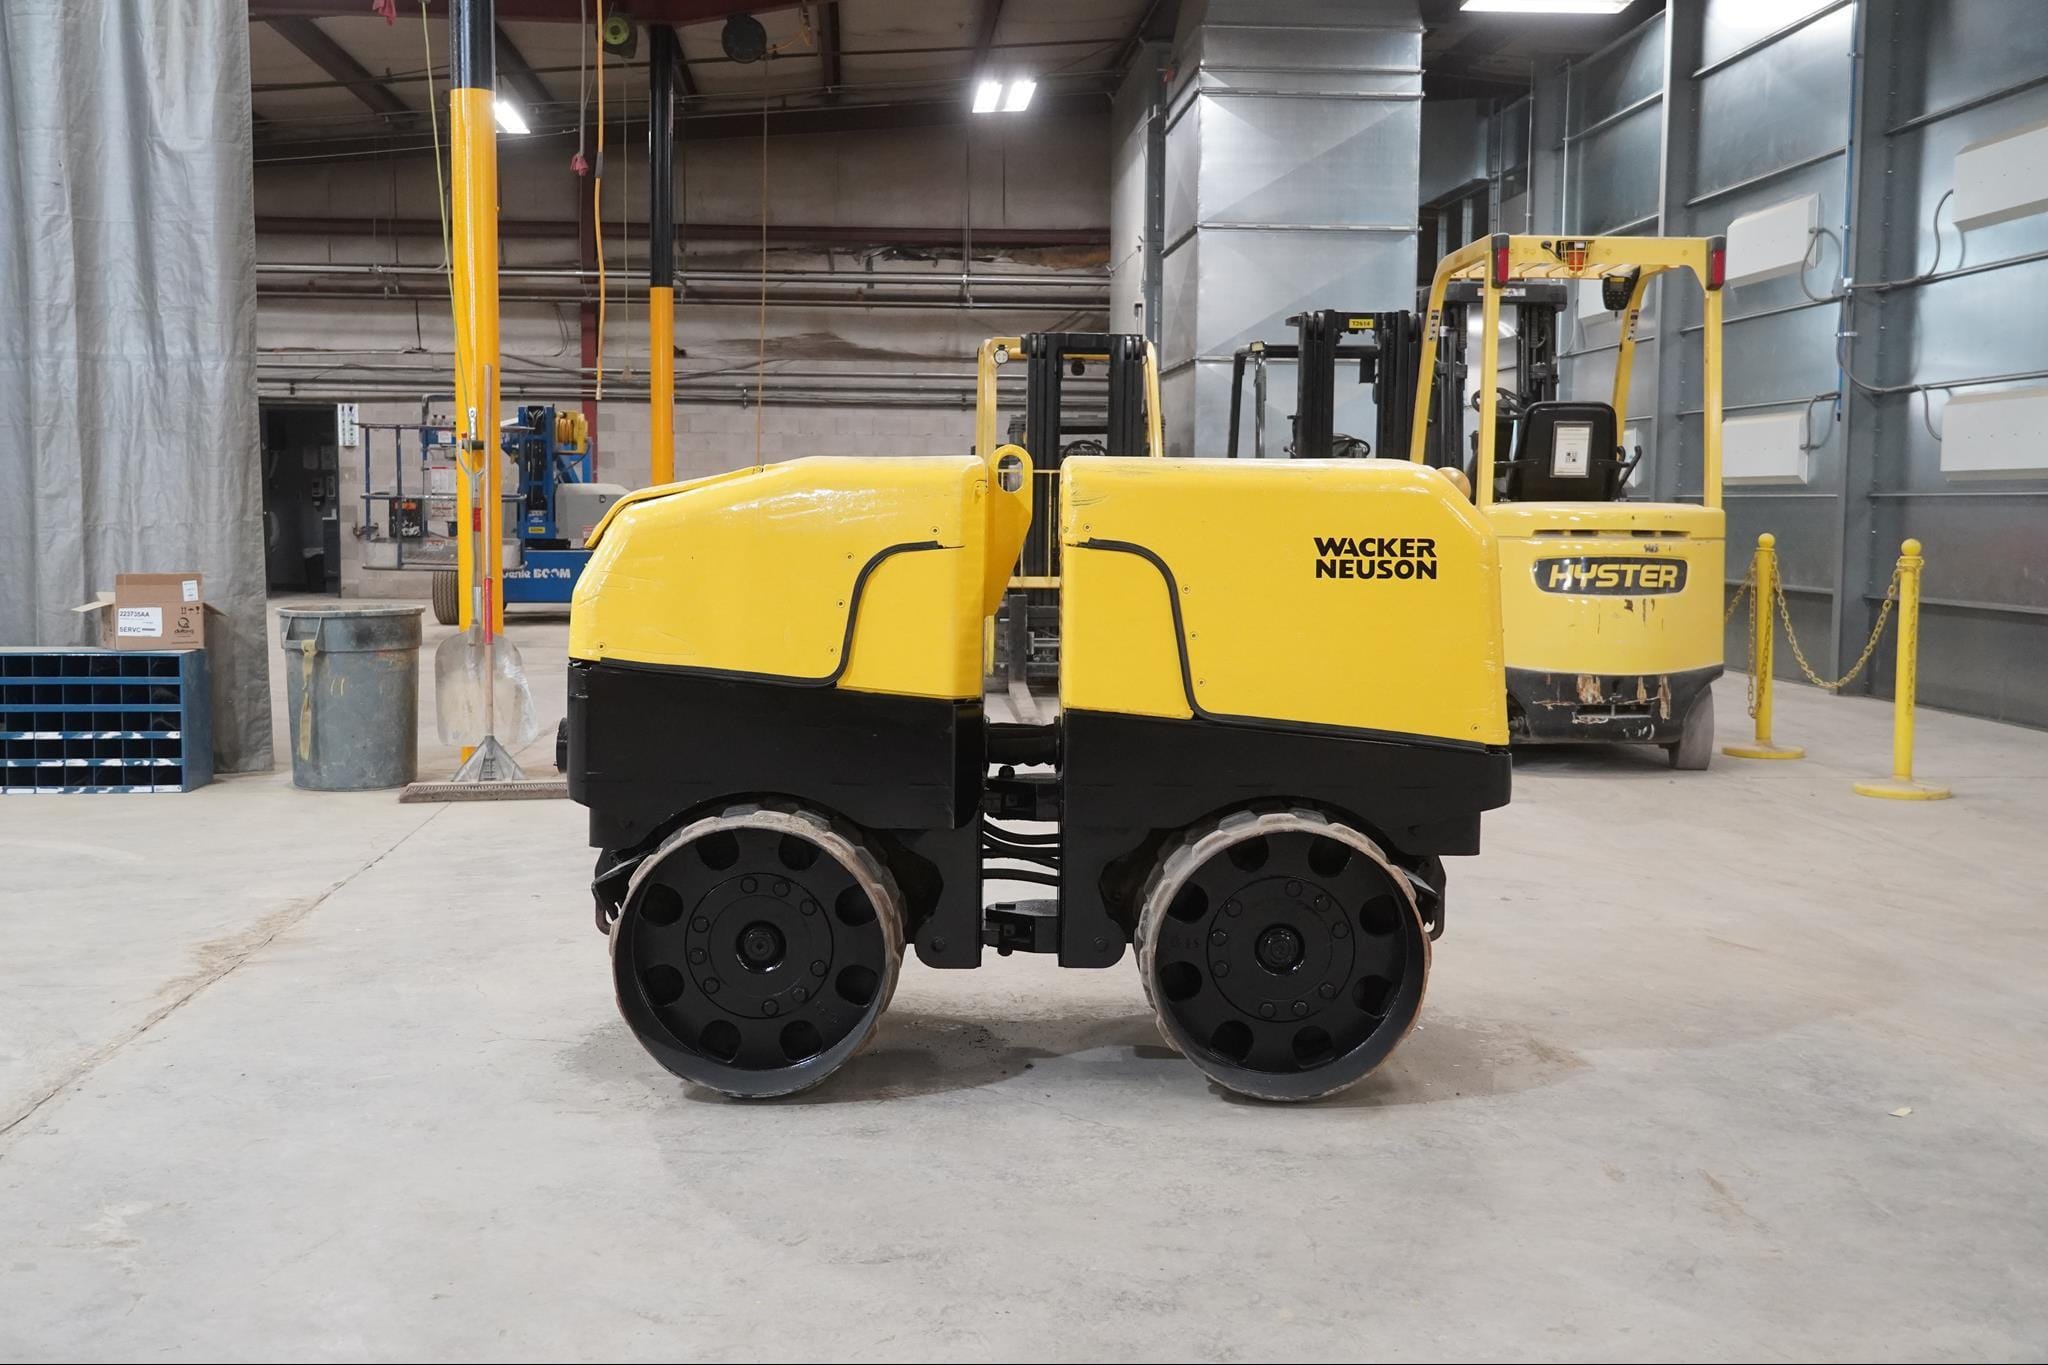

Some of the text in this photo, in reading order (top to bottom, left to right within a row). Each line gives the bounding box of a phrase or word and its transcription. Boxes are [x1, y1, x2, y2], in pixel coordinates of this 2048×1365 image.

[1313, 537, 1437, 558] WACKER
[533, 568, 571, 578] BOOM
[1315, 559, 1437, 579] NEUSON
[1548, 564, 1678, 588] HYSTER
